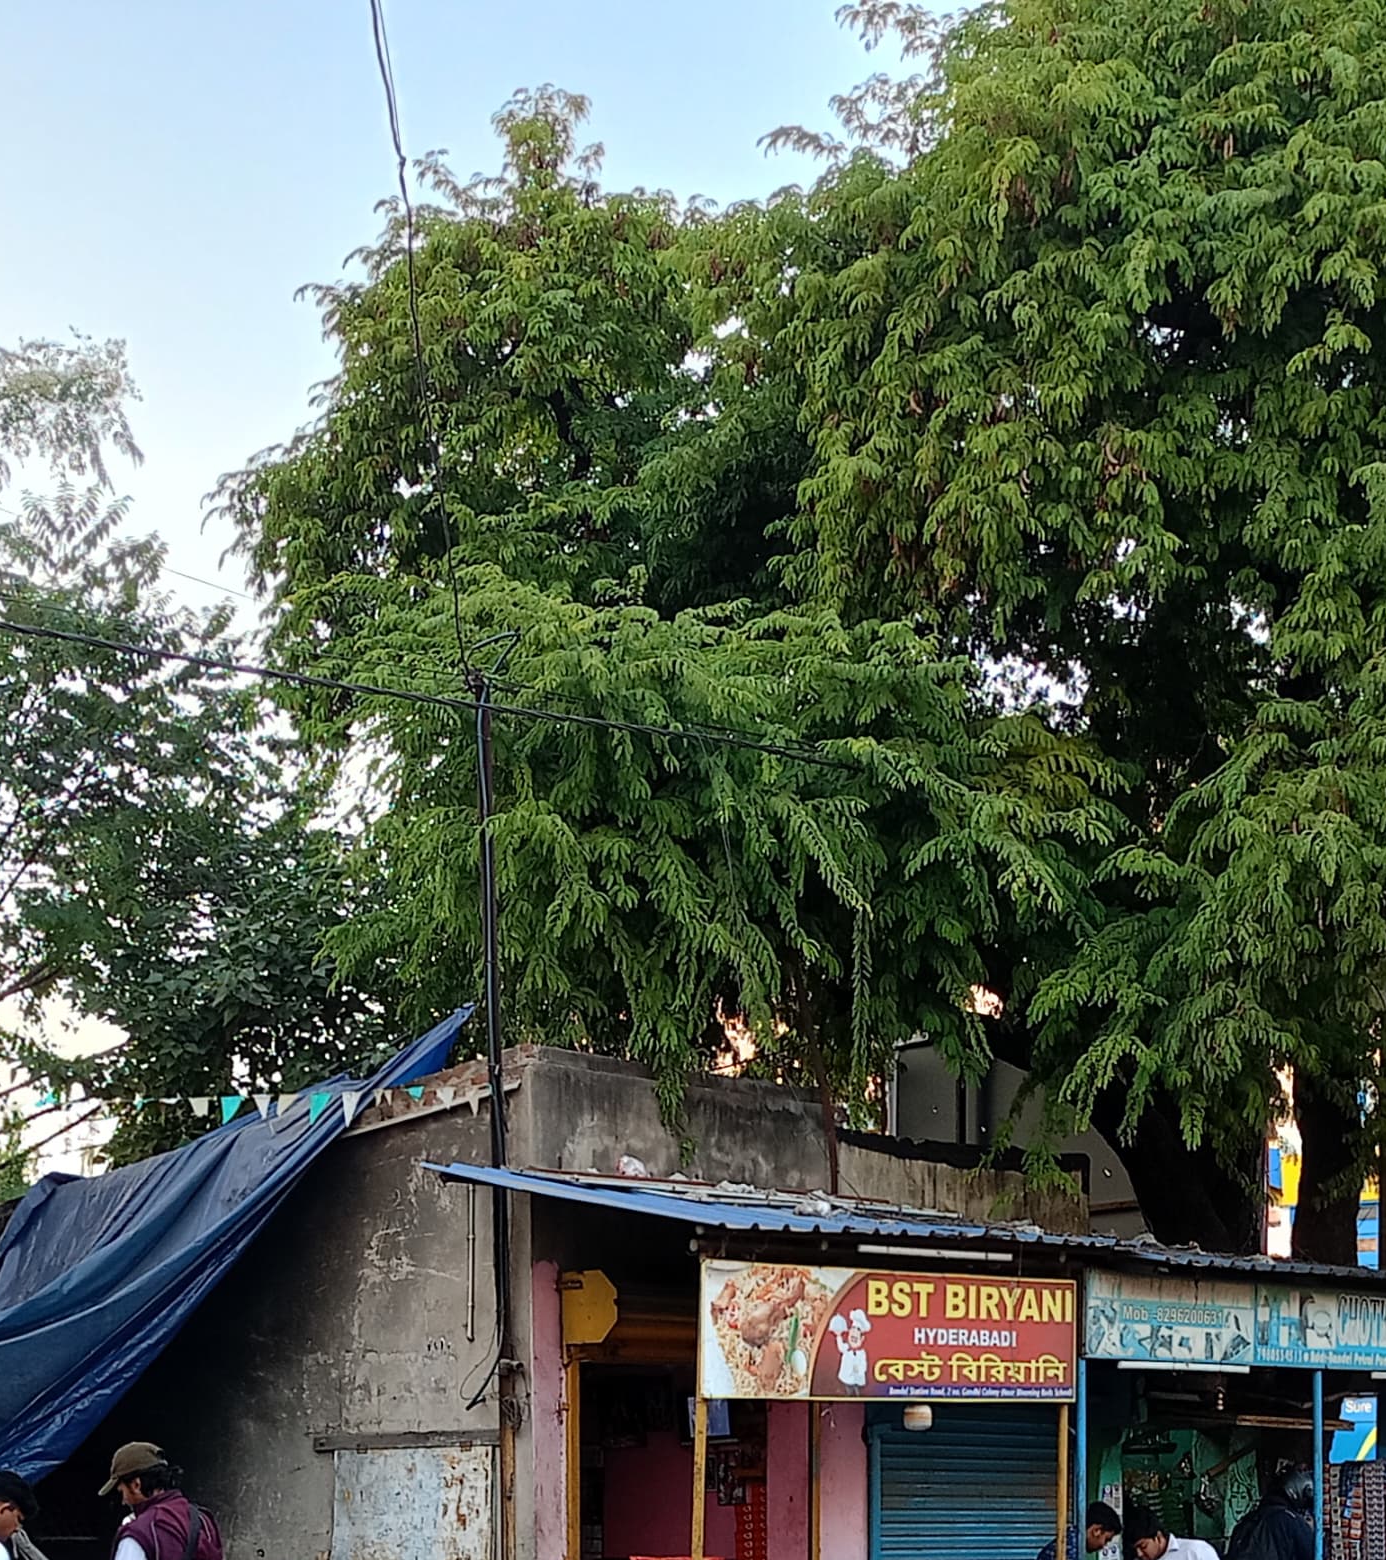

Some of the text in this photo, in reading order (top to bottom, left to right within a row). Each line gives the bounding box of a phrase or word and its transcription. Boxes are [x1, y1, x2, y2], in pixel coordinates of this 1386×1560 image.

[867, 1279, 1073, 1323] BST BIRYANI
[913, 1327, 1017, 1348] HYDERABADI
[873, 1351, 1068, 1384] বেস্ট বিরিয়ানি
[1344, 1399, 1373, 1414] Sure
